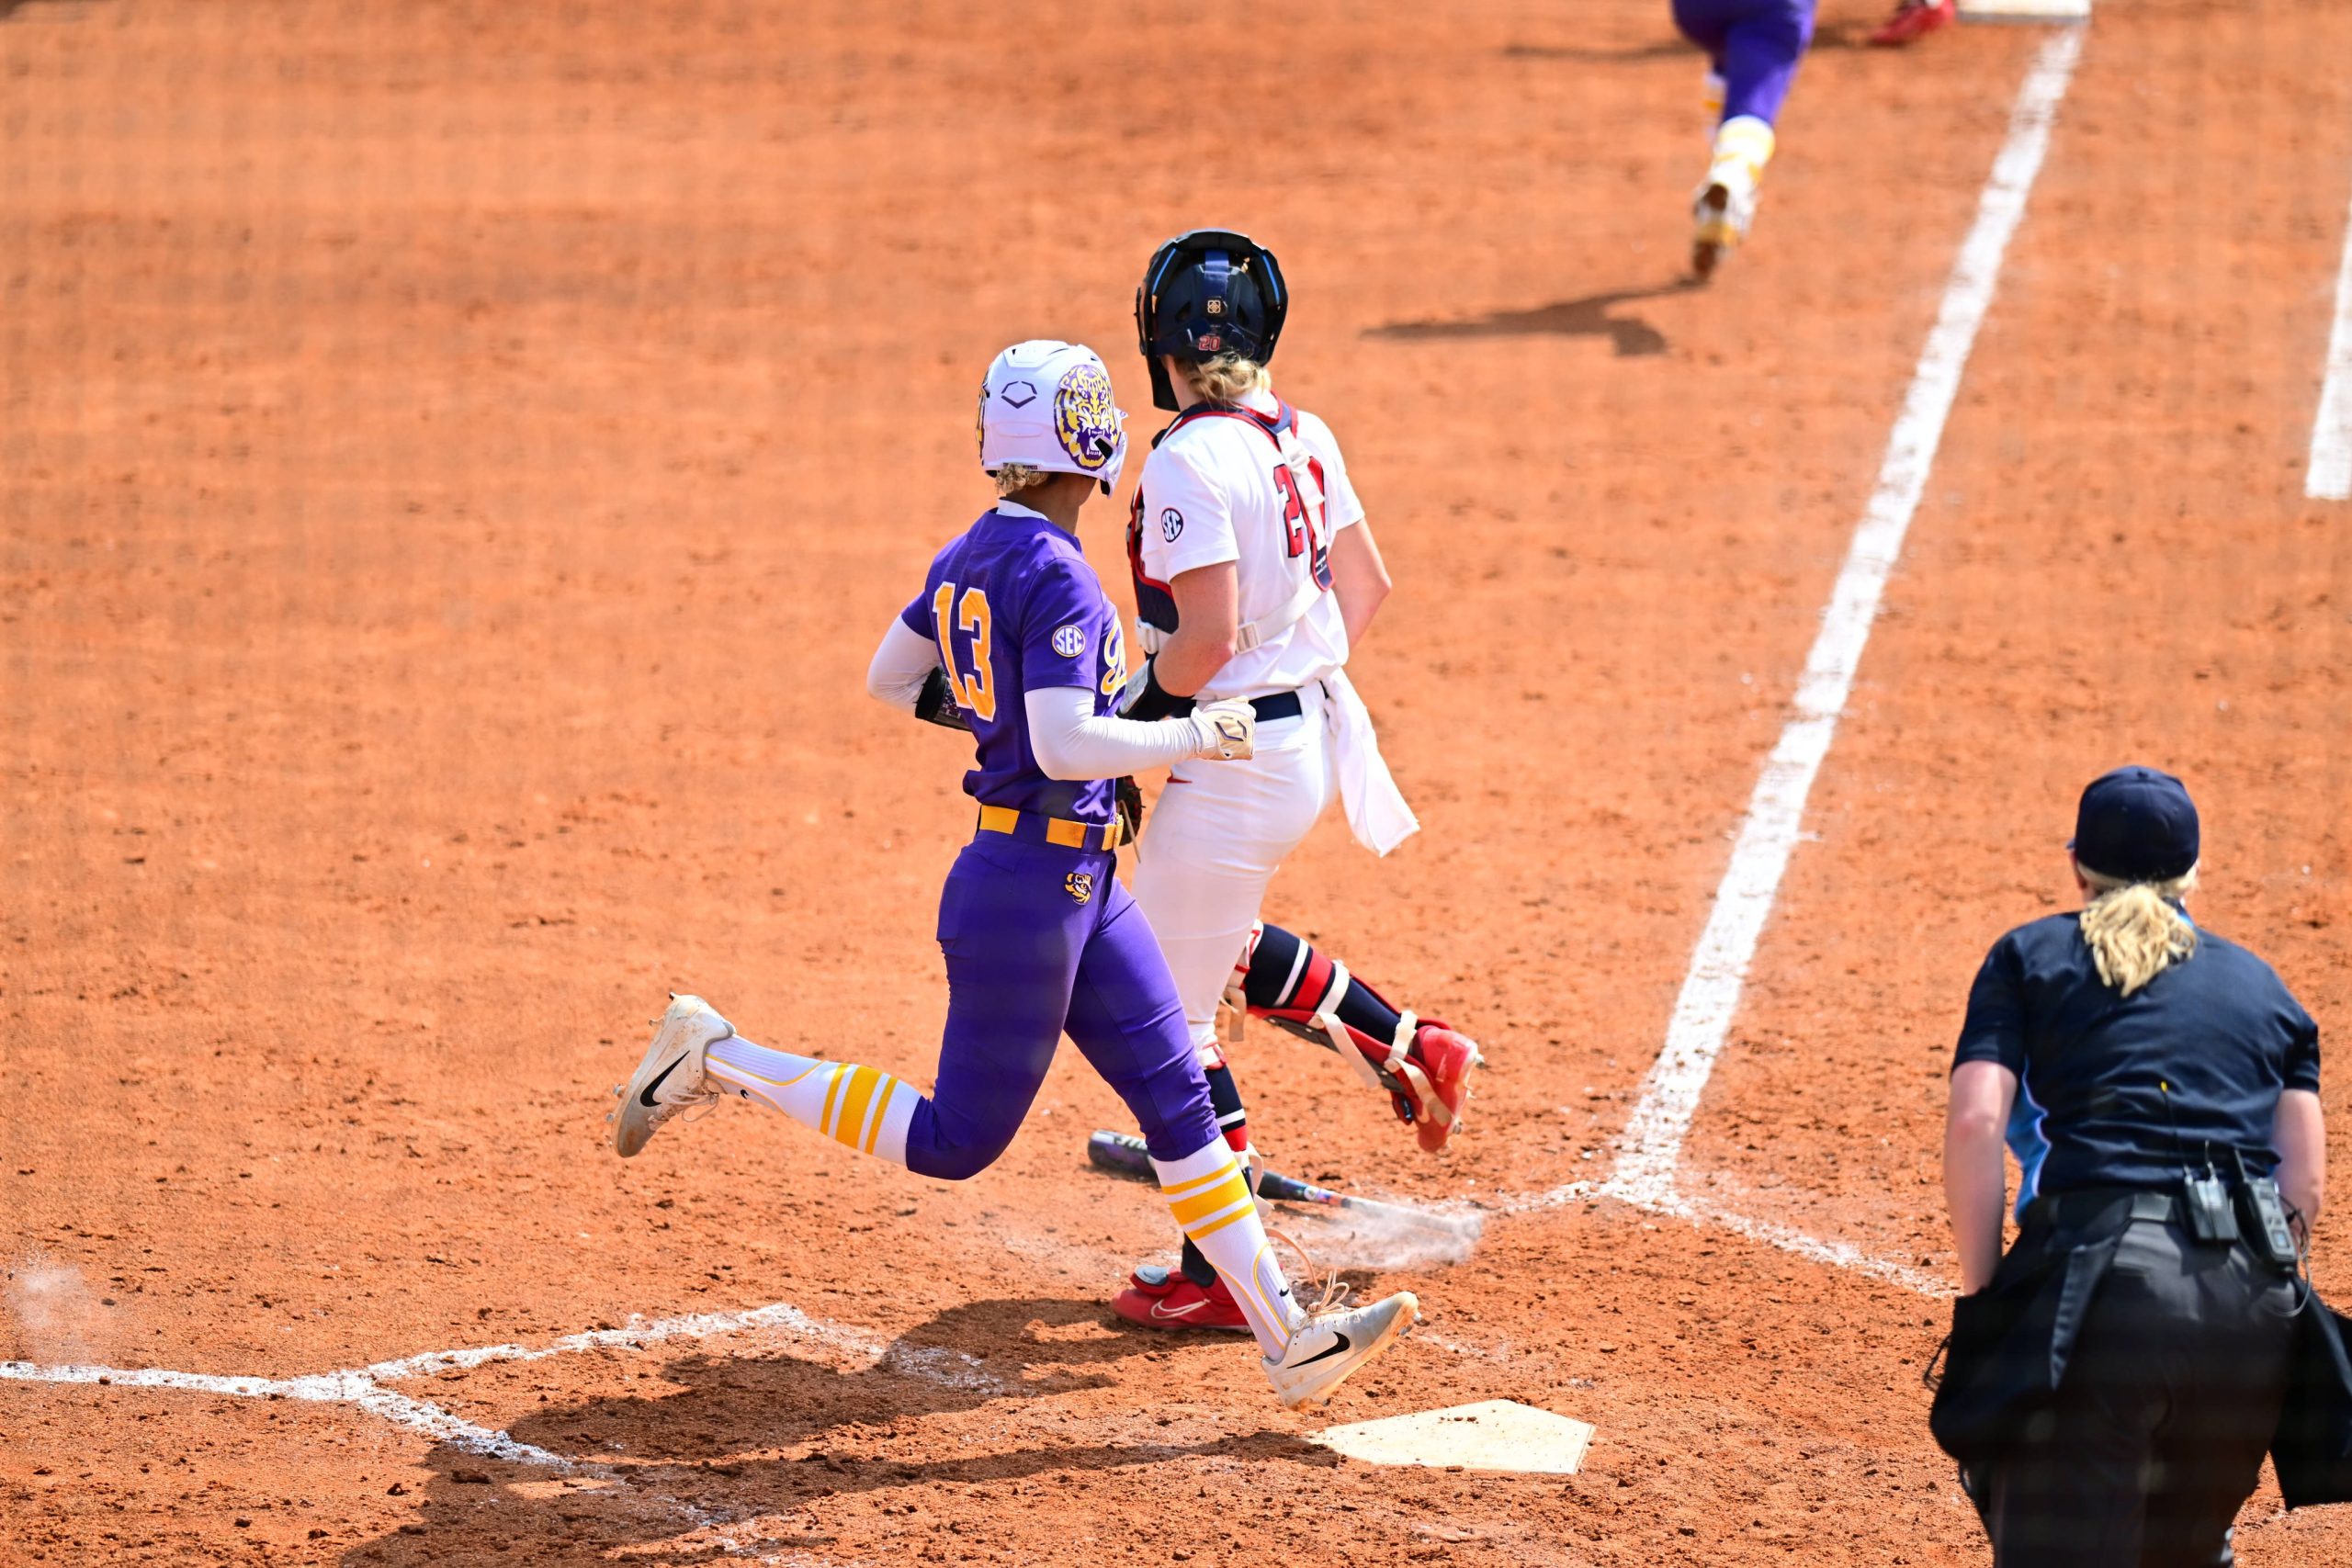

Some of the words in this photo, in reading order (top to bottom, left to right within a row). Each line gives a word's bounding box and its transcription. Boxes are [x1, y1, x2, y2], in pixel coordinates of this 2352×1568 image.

[1198, 335, 1220, 351] 20
[1162, 509, 1182, 541] SEC
[933, 581, 996, 722] 13
[1055, 626, 1083, 655] SEC
